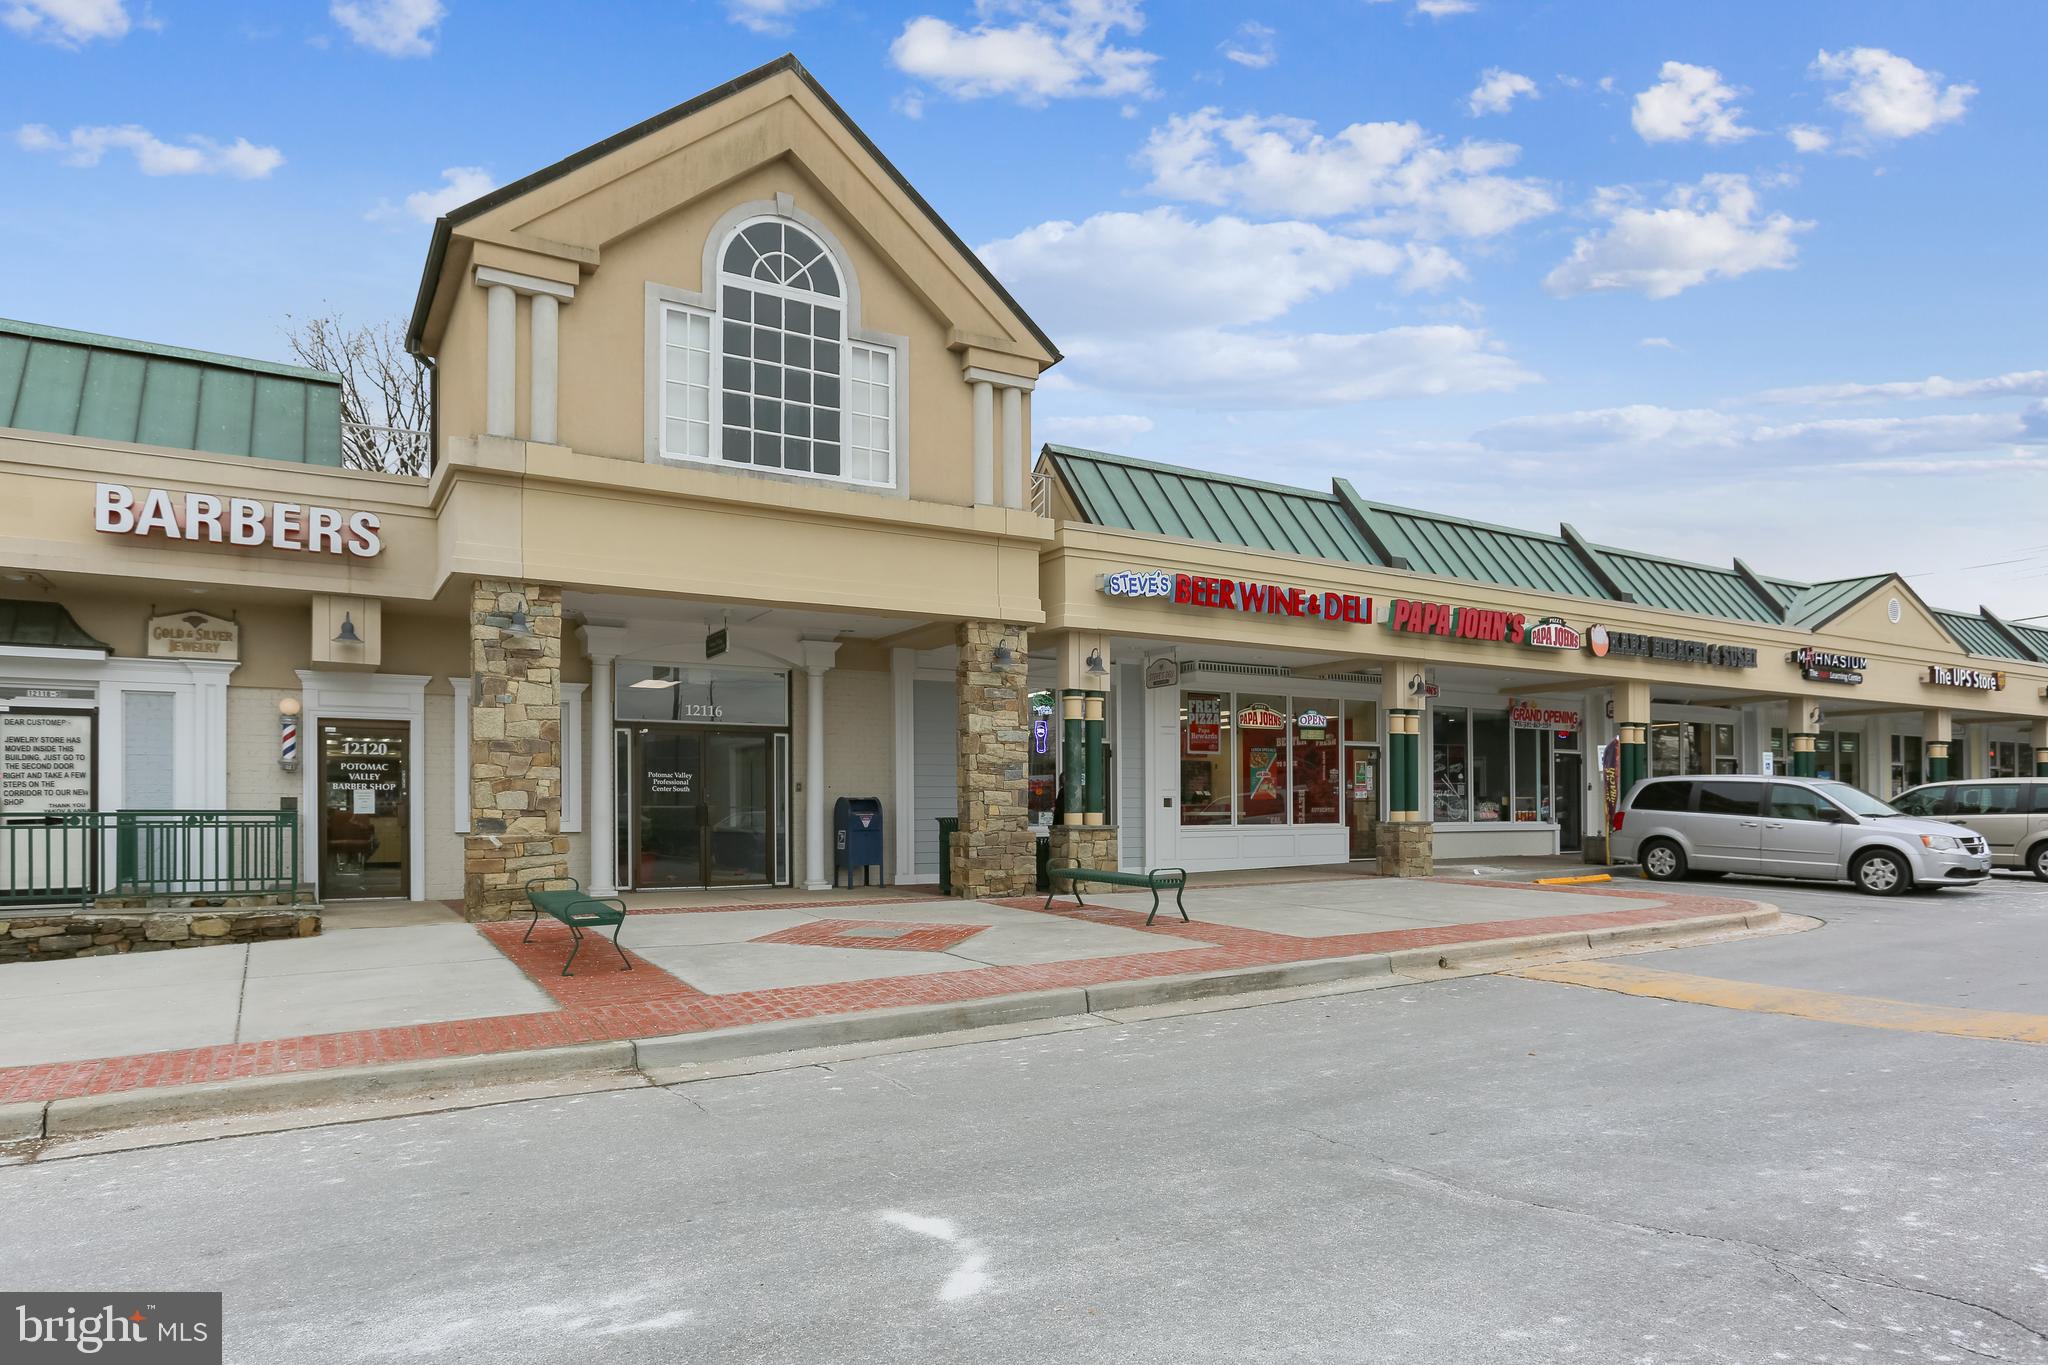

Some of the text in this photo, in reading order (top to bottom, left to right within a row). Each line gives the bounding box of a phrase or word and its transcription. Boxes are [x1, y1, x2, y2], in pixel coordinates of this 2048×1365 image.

[95, 482, 382, 557] BARBERS
[1110, 572, 1373, 624] STEVE'S BEER WINE & DELI
[1392, 599, 1526, 645] PAPA JOHN'S
[153, 627, 233, 641] GOLD & SILVER
[1532, 627, 1579, 648] PAPA JOHNS
[168, 640, 220, 653] JEWELRY
[1934, 666, 1997, 690] The UPS Store
[685, 704, 723, 717] 12116
[1189, 700, 1219, 713] FREE
[1188, 713, 1219, 724] PIZZA
[1240, 712, 1281, 726] PAPA JOHNS
[1300, 714, 1327, 726] OPEN
[1513, 708, 1578, 724] GRAND OPENING
[341, 742, 388, 755] 12120
[340, 762, 389, 771] POTOMAC
[348, 773, 380, 781] VALLEY
[675, 771, 693, 780] Valley
[370, 783, 396, 791] SHOP
